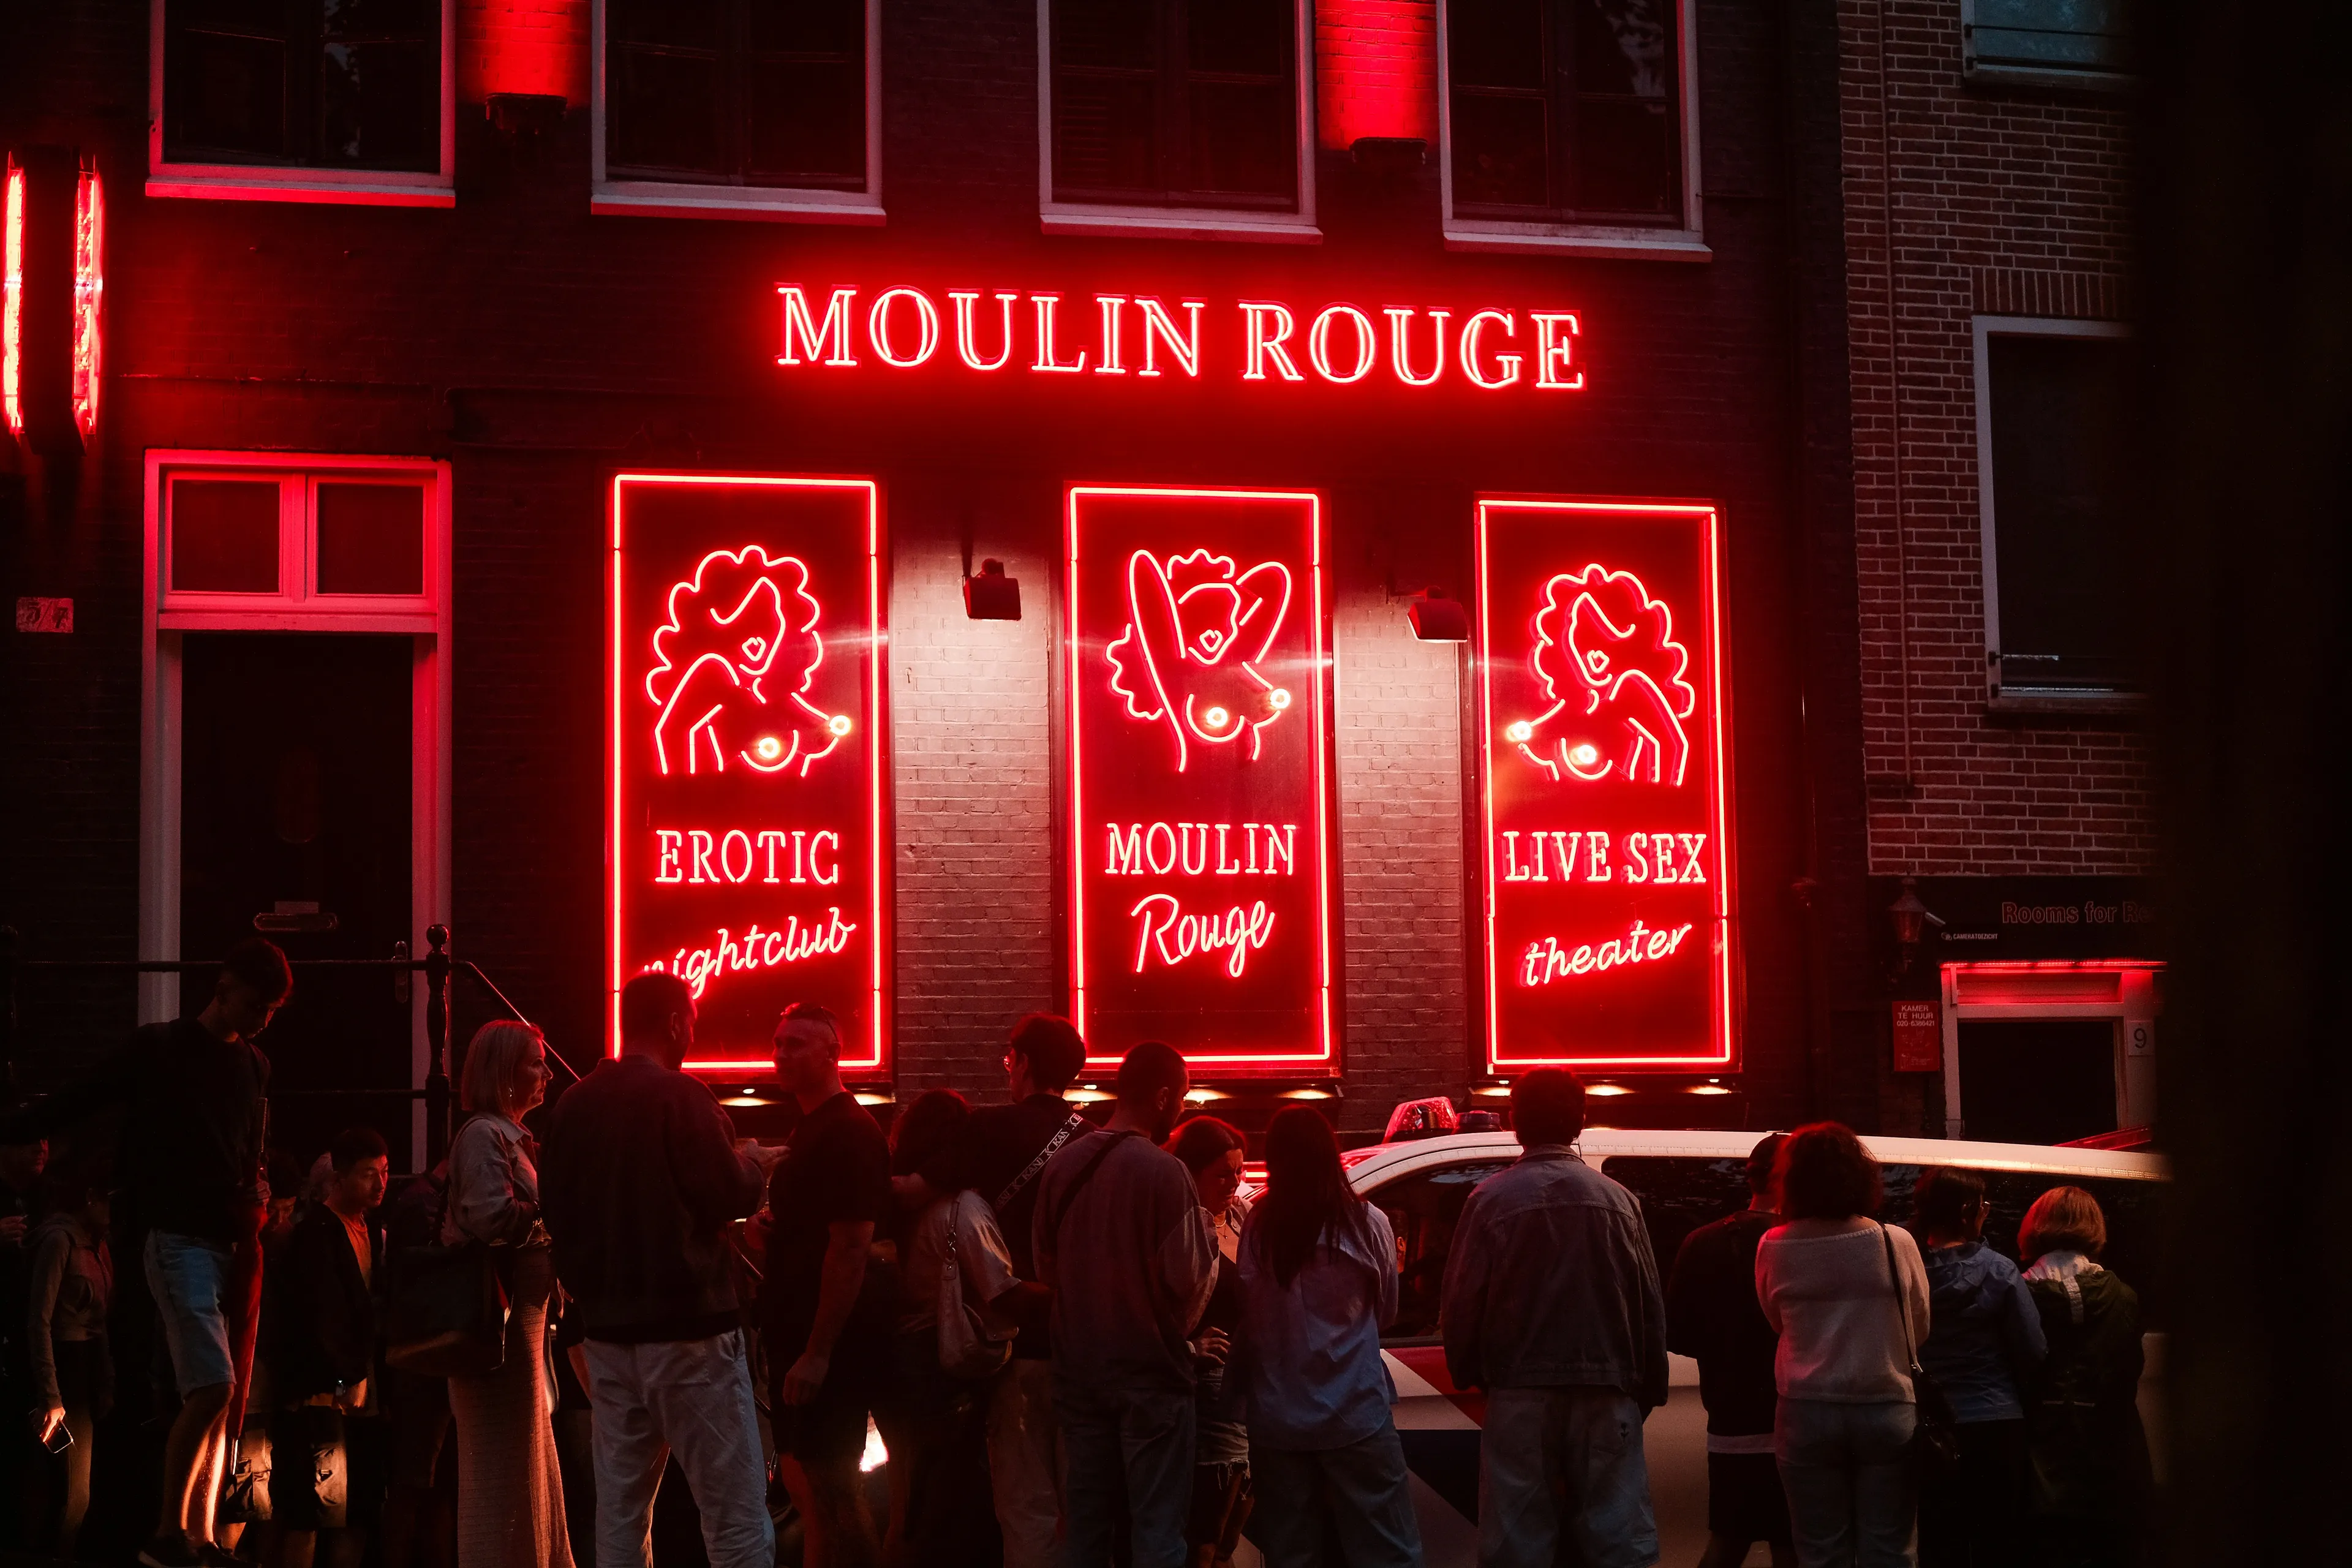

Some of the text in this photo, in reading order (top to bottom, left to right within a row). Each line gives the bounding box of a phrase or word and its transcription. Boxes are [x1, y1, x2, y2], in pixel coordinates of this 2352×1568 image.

[775, 283, 1586, 391] MOULIN ROUGE
[655, 829, 839, 884] EROTIC
[1104, 822, 1297, 875] MOULIN
[1502, 831, 1707, 883] LIVE SEX
[1131, 893, 1275, 978] Rouge
[2002, 902, 2079, 923] Rooms
[2084, 901, 2117, 923] for
[1525, 920, 1692, 986] theater
[2133, 1028, 2147, 1049] 9
